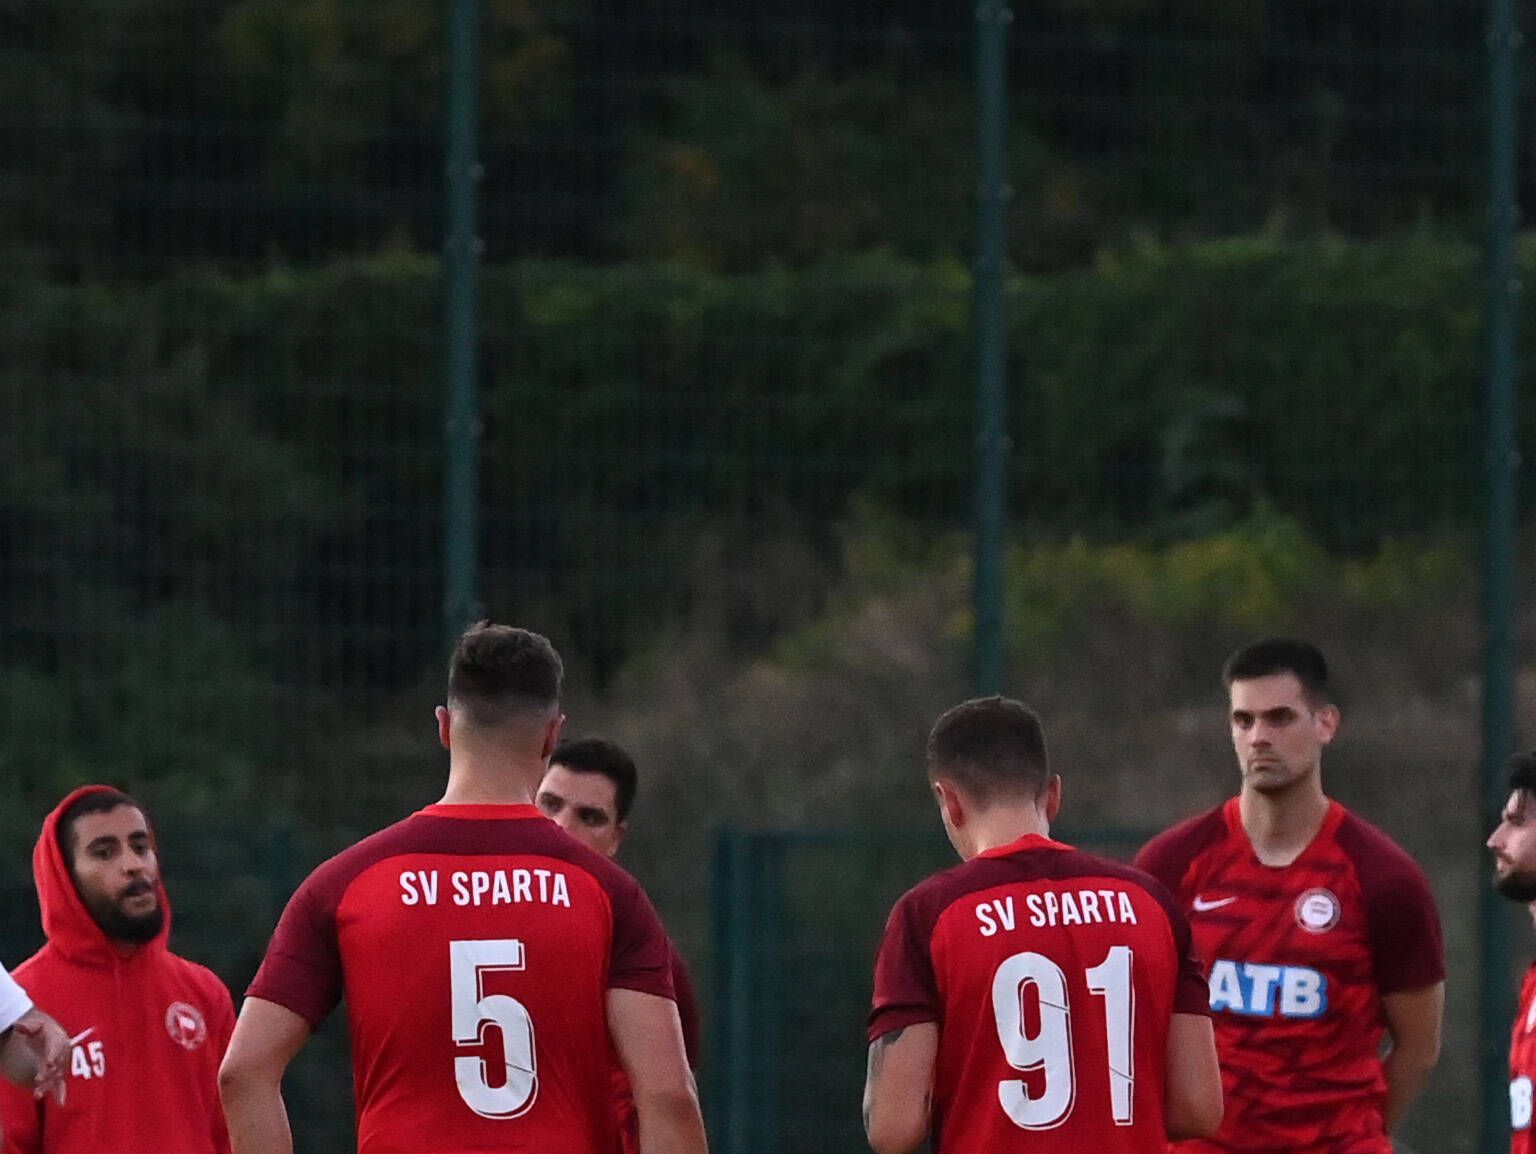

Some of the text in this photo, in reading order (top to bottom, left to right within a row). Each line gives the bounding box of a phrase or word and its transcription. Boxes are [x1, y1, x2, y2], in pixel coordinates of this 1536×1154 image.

[398, 868, 571, 908] SV SPARTA
[975, 890, 1137, 937] SV SPARTA
[1208, 959, 1327, 1018] ATB
[449, 939, 539, 1120] 5
[991, 945, 1135, 1131] 91
[71, 1041, 106, 1080] 45
